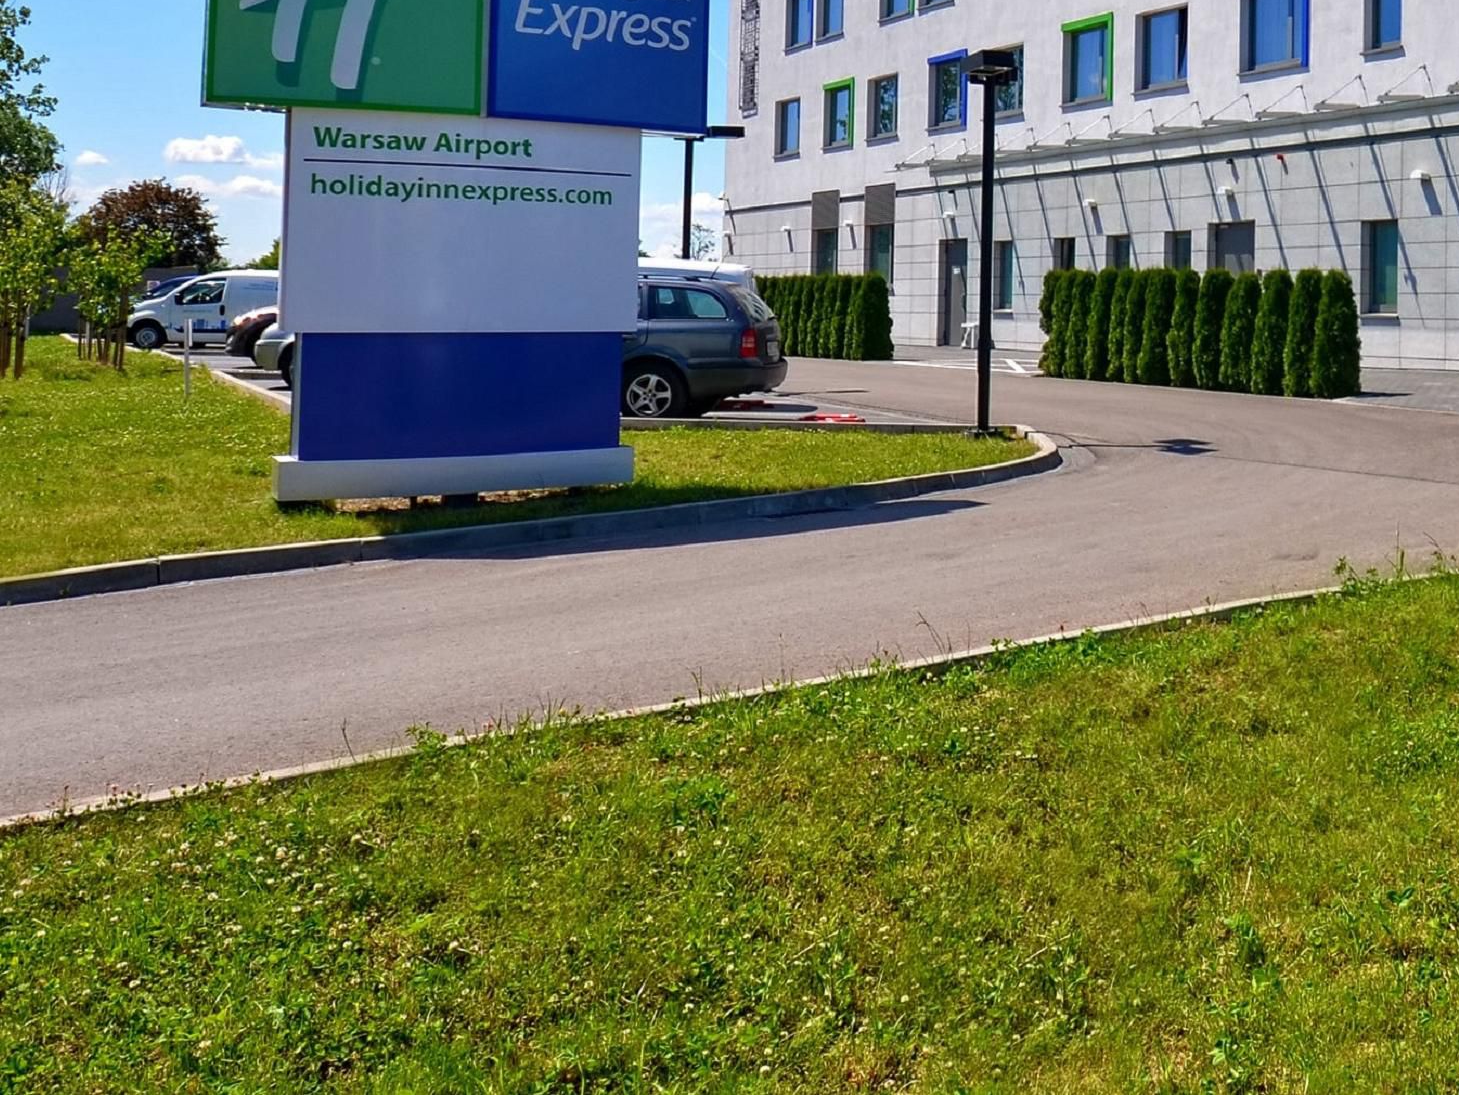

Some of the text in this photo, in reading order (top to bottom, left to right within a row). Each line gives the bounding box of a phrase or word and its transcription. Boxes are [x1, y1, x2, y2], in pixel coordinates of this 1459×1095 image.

[313, 126, 533, 160] Warsaw Airport
[310, 173, 613, 205] holidayinnexpress.com
